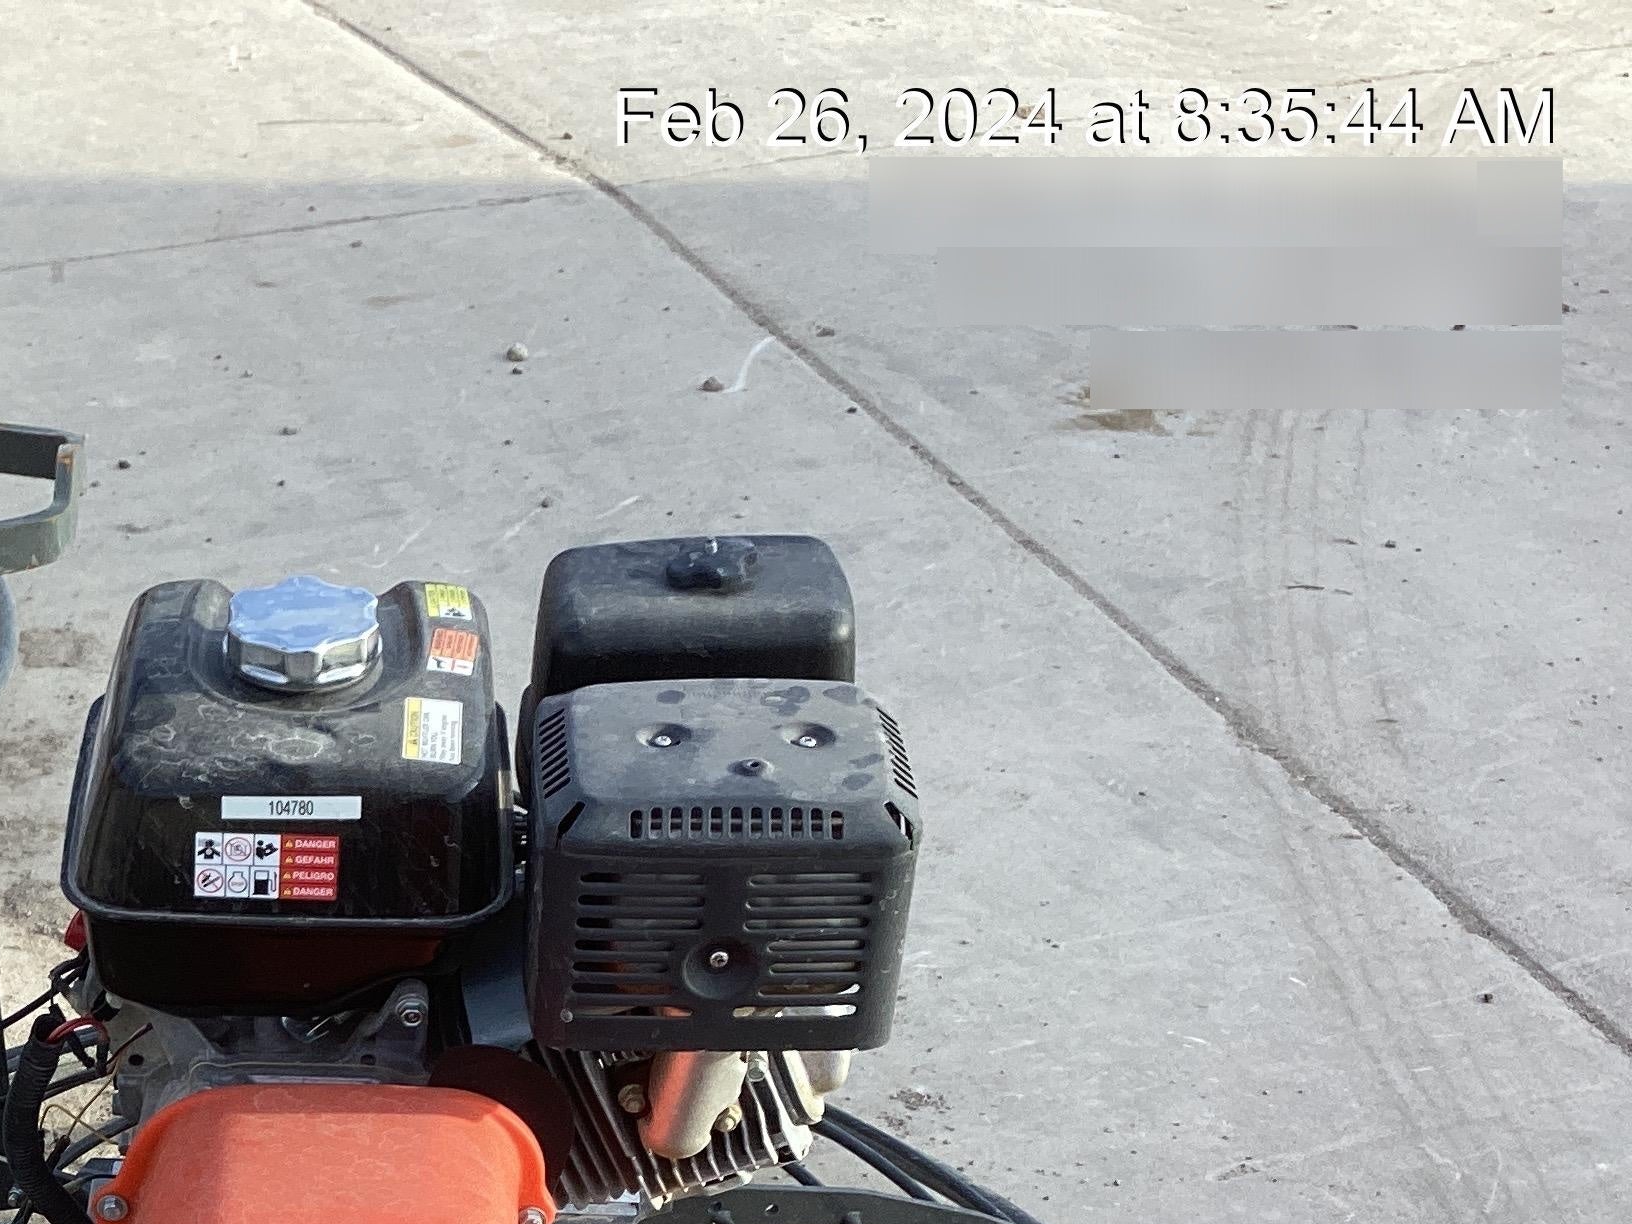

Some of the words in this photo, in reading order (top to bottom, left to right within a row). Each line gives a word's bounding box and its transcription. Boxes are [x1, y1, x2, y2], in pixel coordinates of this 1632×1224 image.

[268, 801, 315, 817] 104780
[294, 839, 336, 849] DANGER
[294, 855, 335, 865] GEFAHR
[292, 871, 335, 881] PELIGRO
[292, 887, 334, 897] DANGER
